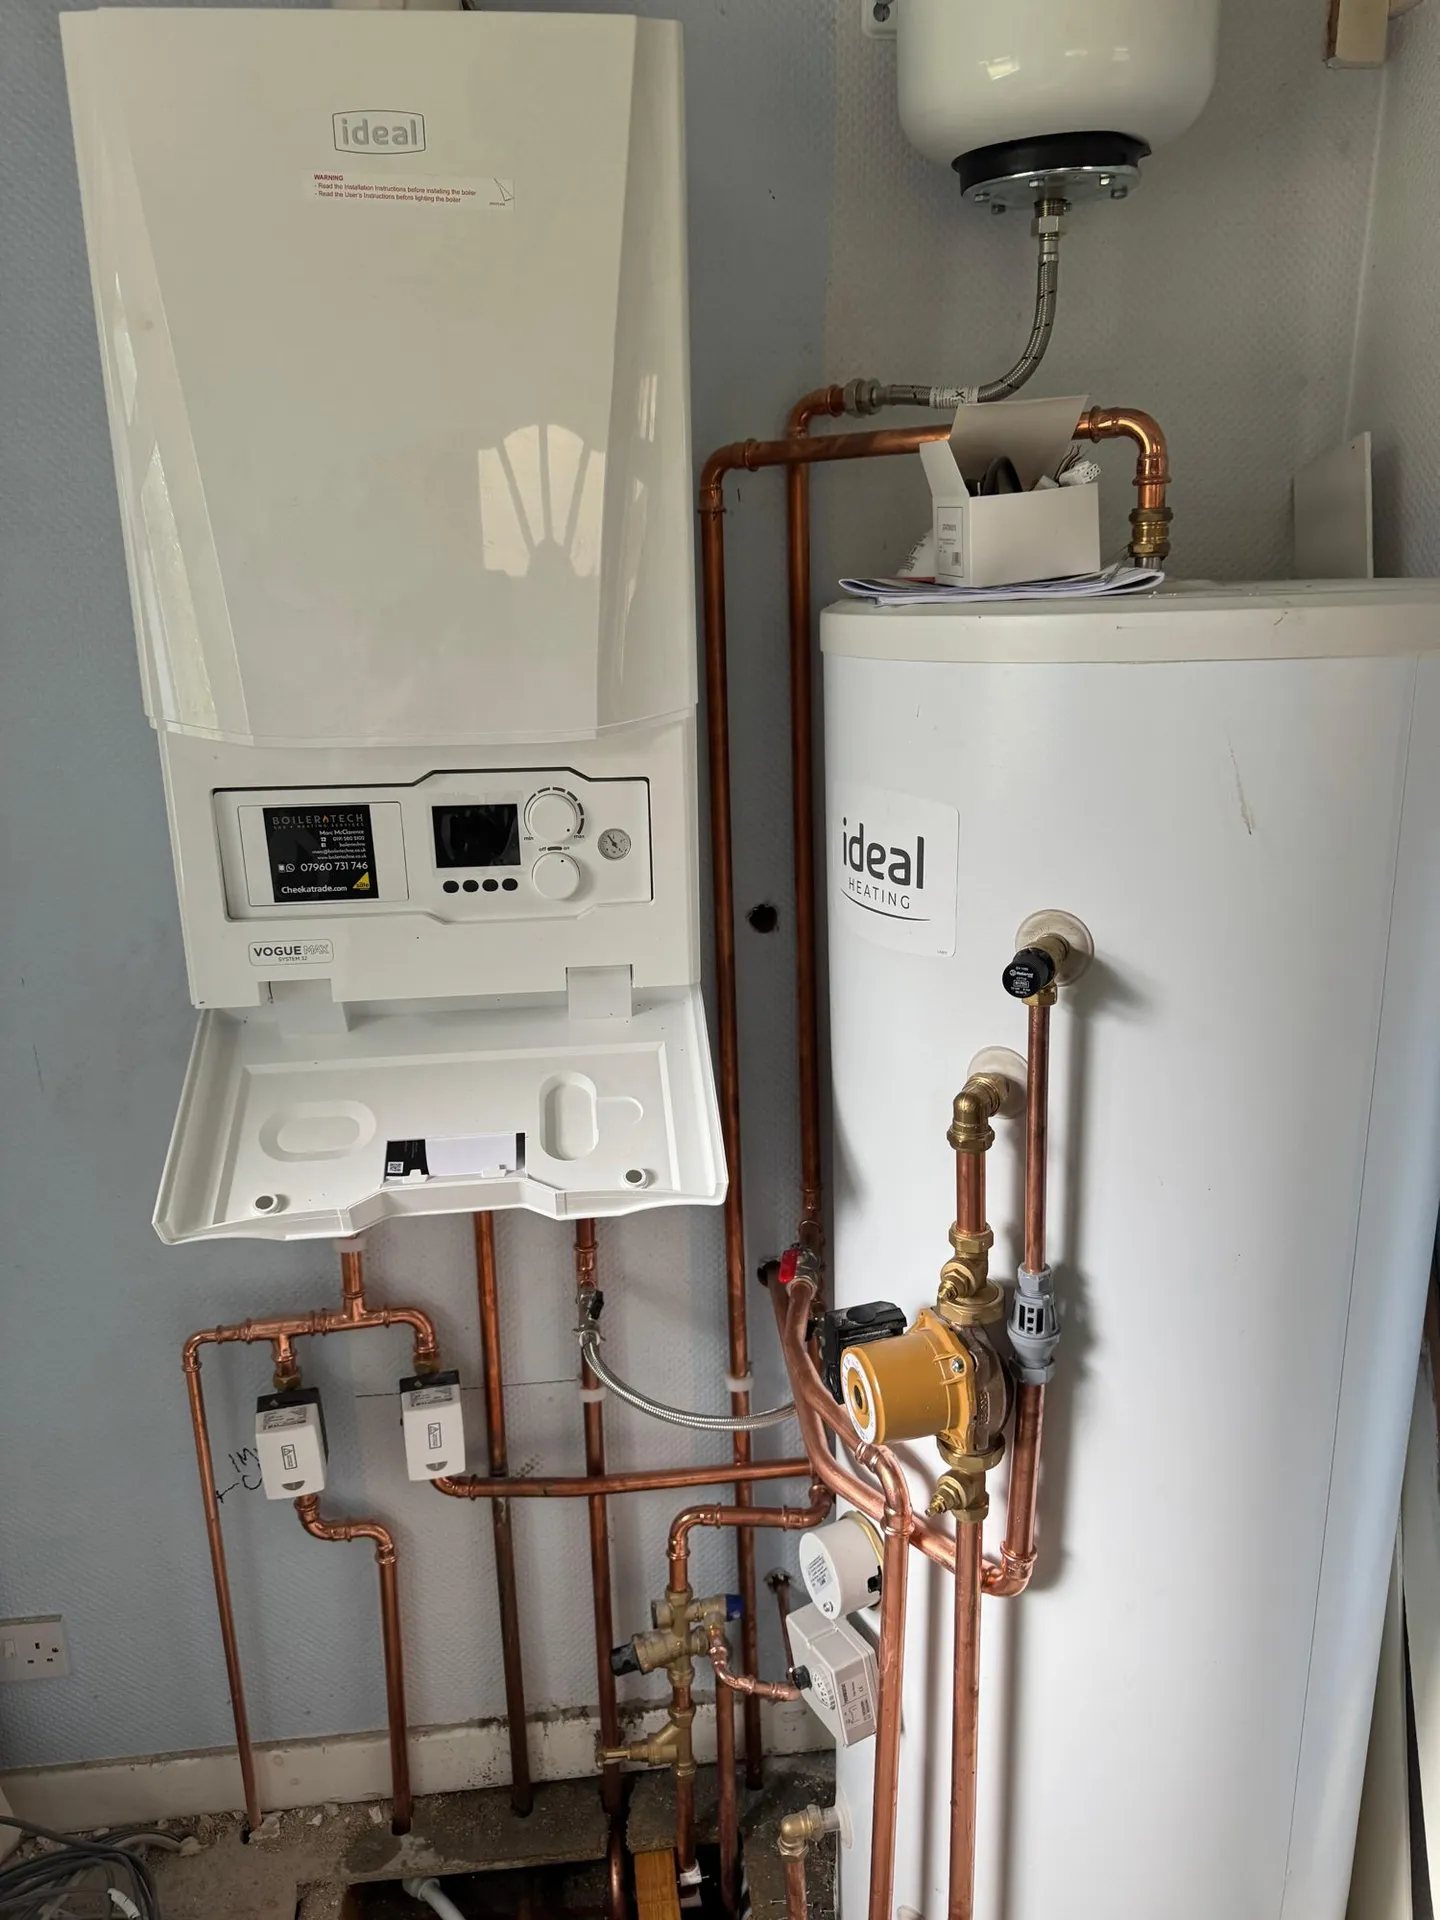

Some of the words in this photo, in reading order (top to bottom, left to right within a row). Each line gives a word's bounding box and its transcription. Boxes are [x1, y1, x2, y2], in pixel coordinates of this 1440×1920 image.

[341, 117, 418, 146] ideal
[843, 816, 925, 890] ideal
[300, 862, 332, 872] 07960
[334, 862, 349, 871] 731
[351, 861, 368, 870] 746
[281, 885, 348, 894] Checkatrade.com
[848, 876, 910, 910] HEATING
[253, 945, 302, 957] VOGUE
[302, 944, 329, 955] MAX
